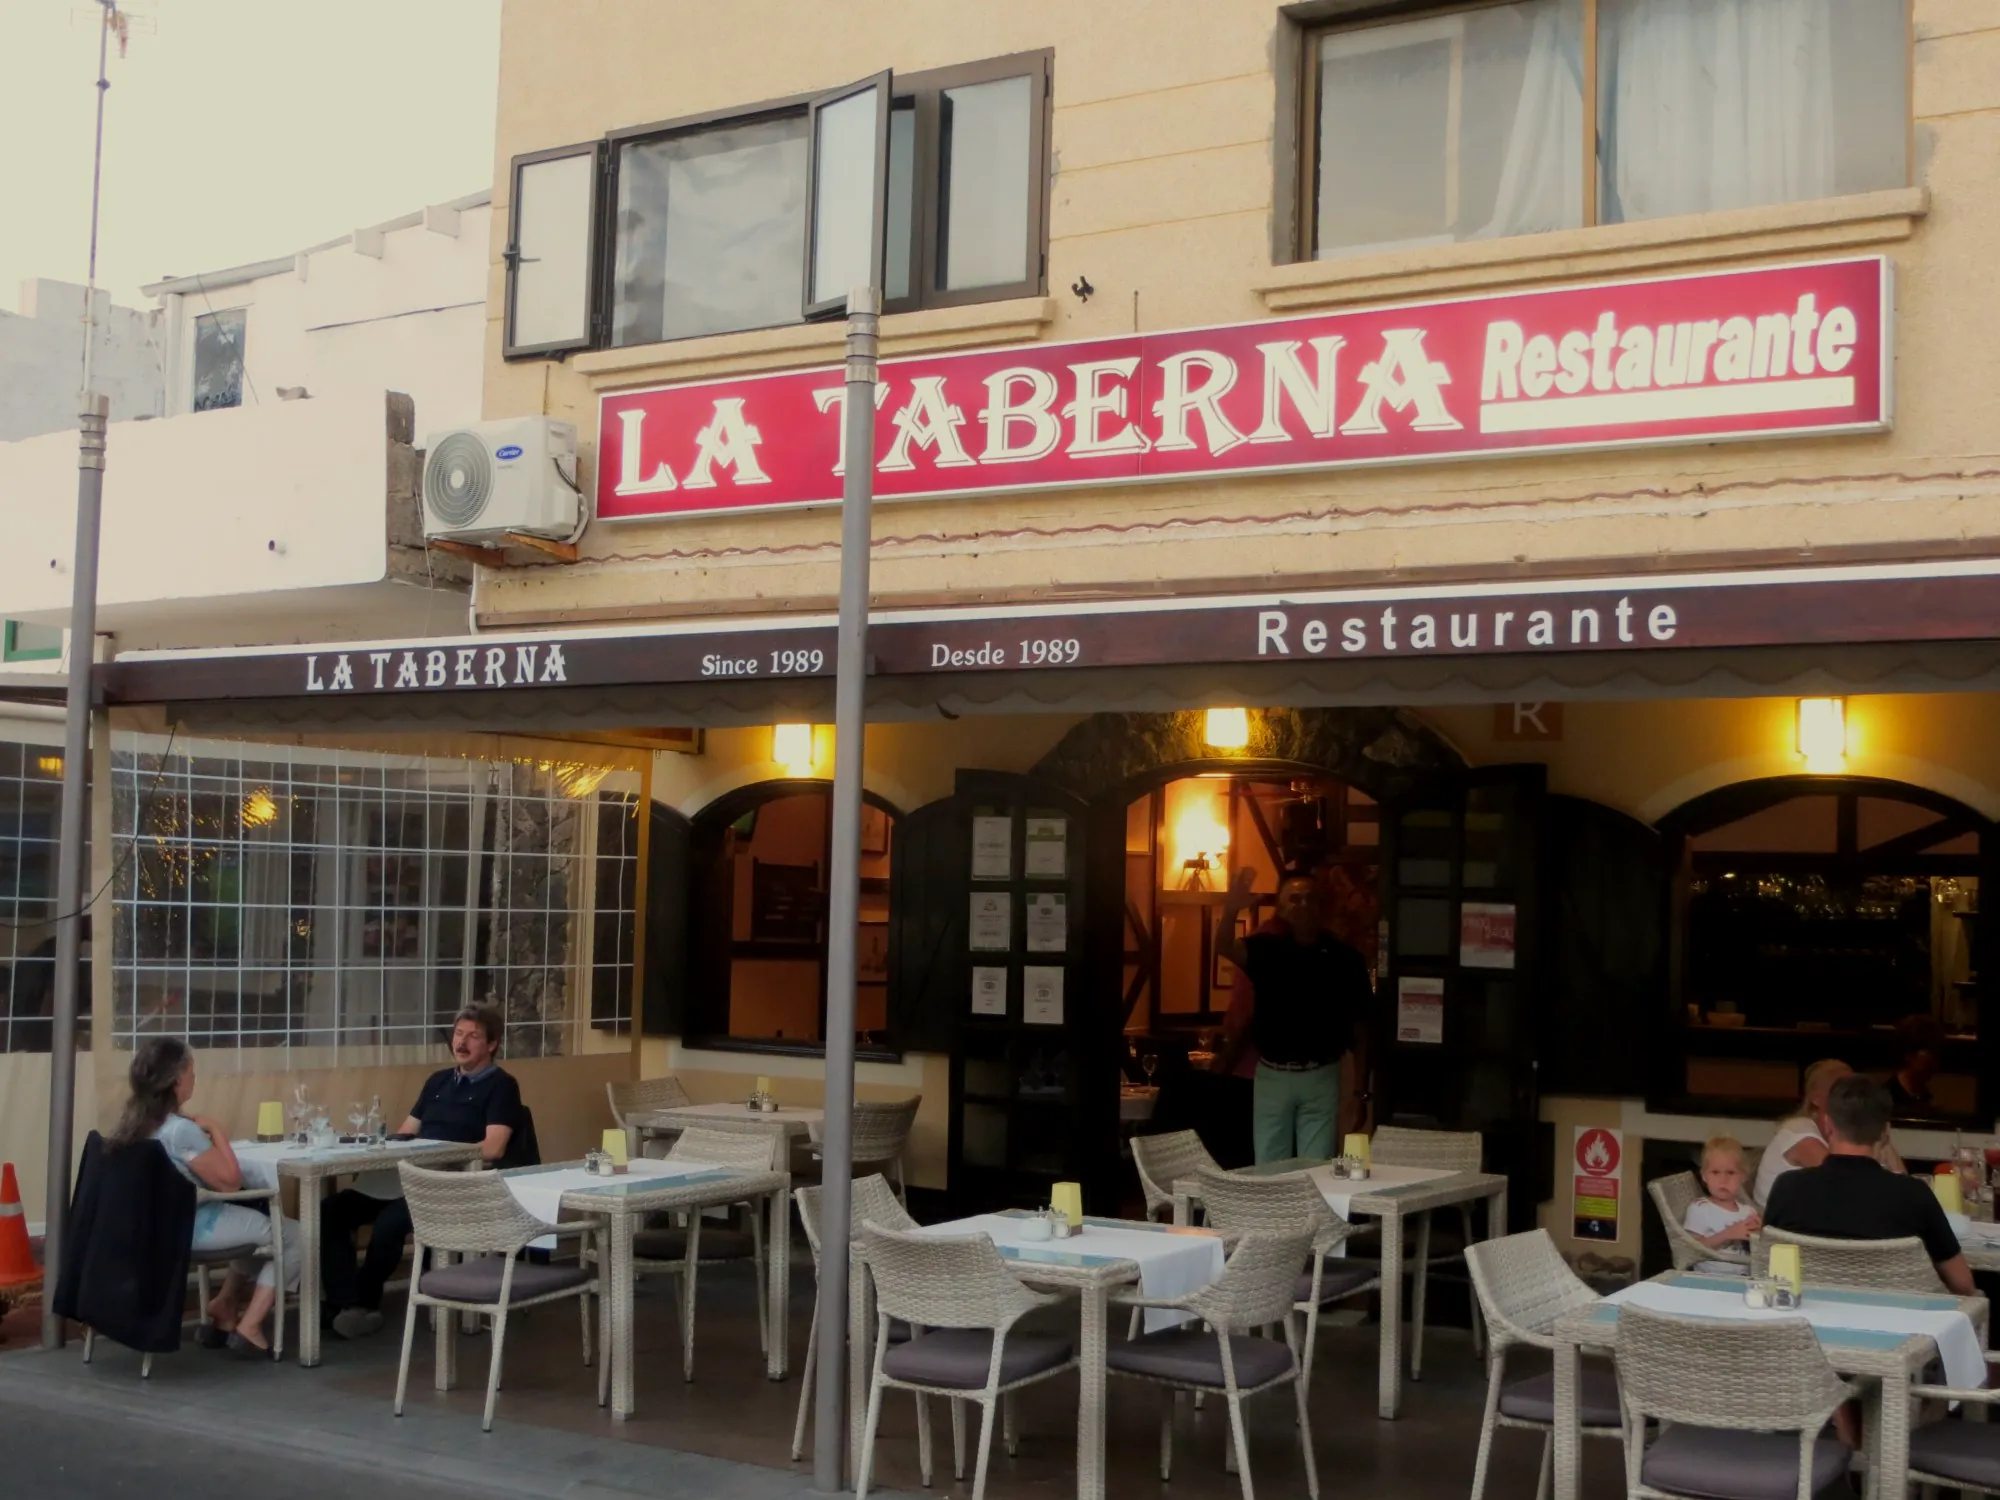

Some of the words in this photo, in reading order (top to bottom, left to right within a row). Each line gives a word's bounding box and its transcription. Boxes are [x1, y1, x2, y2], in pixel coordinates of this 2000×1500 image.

[1480, 293, 1857, 401] Restaurante
[614, 397, 773, 496] LA
[812, 326, 1465, 476] TABERNA
[1257, 598, 1678, 656] Restaurante
[306, 654, 354, 691] LA
[370, 644, 568, 689] TABERNA
[701, 654, 759, 676] Since
[769, 650, 824, 674] 1989
[931, 640, 1005, 668] Desde
[1018, 639, 1081, 665] 1989
